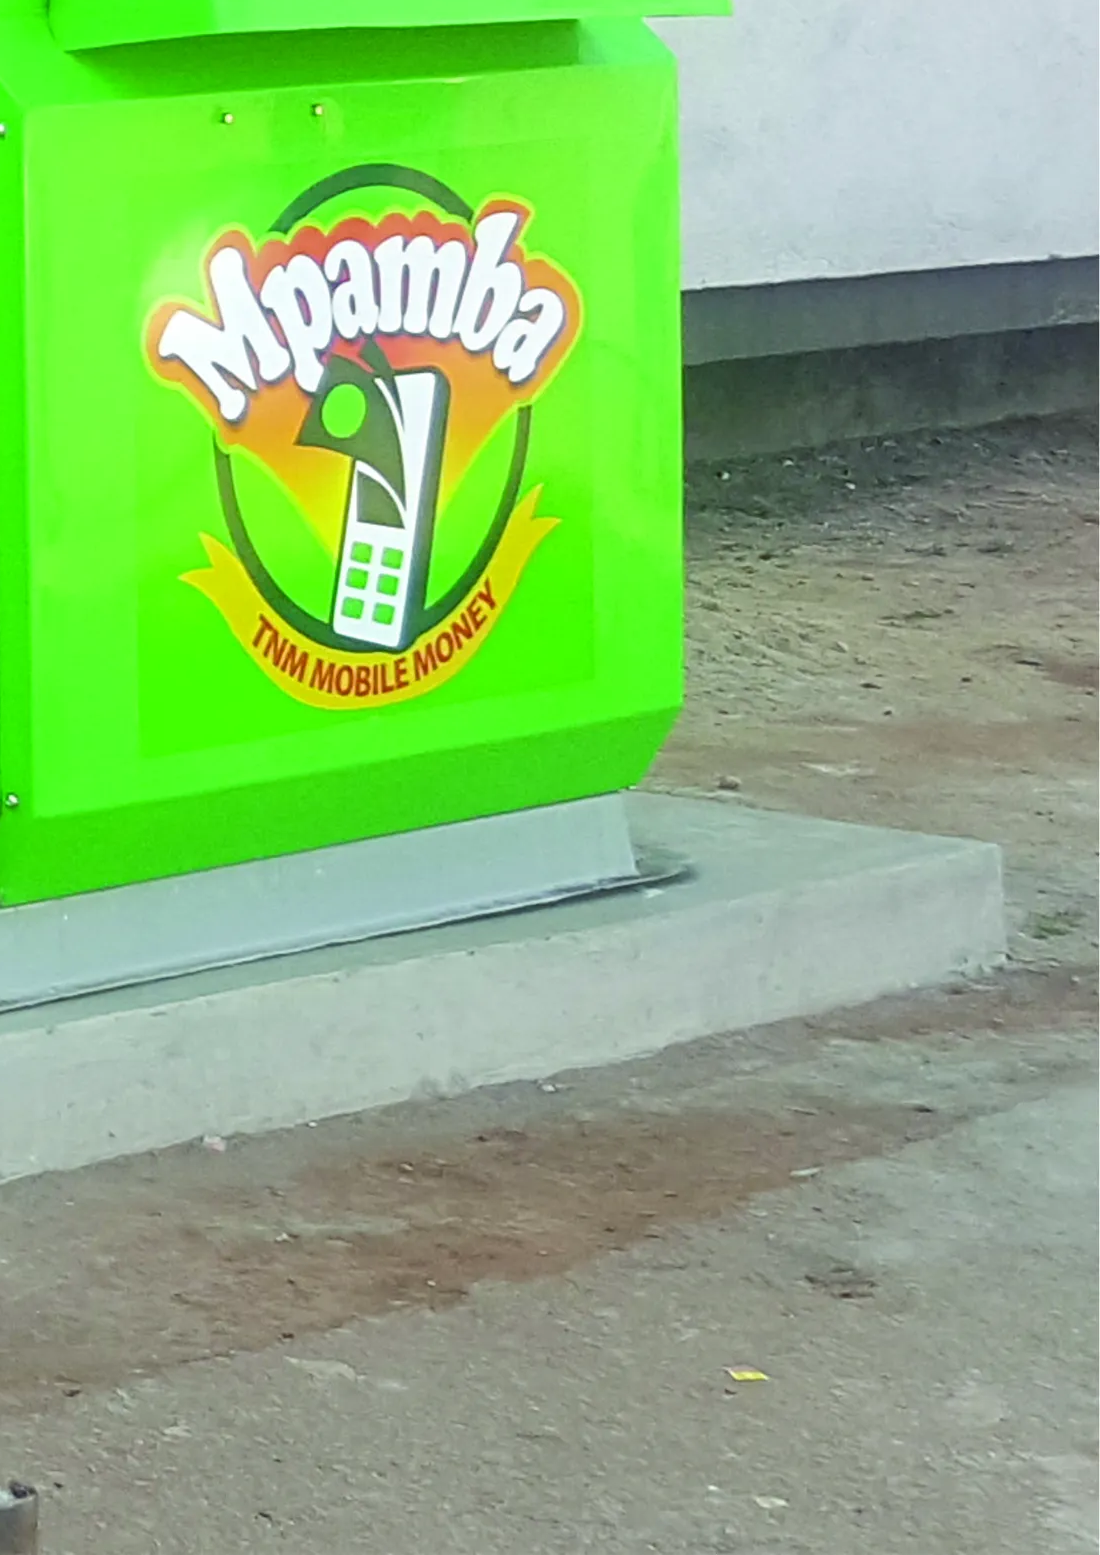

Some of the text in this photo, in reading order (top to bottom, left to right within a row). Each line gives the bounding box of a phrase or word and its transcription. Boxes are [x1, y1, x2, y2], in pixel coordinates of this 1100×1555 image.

[158, 211, 565, 422] Mpamba
[251, 578, 499, 696] TNM MOBILE MONEY
